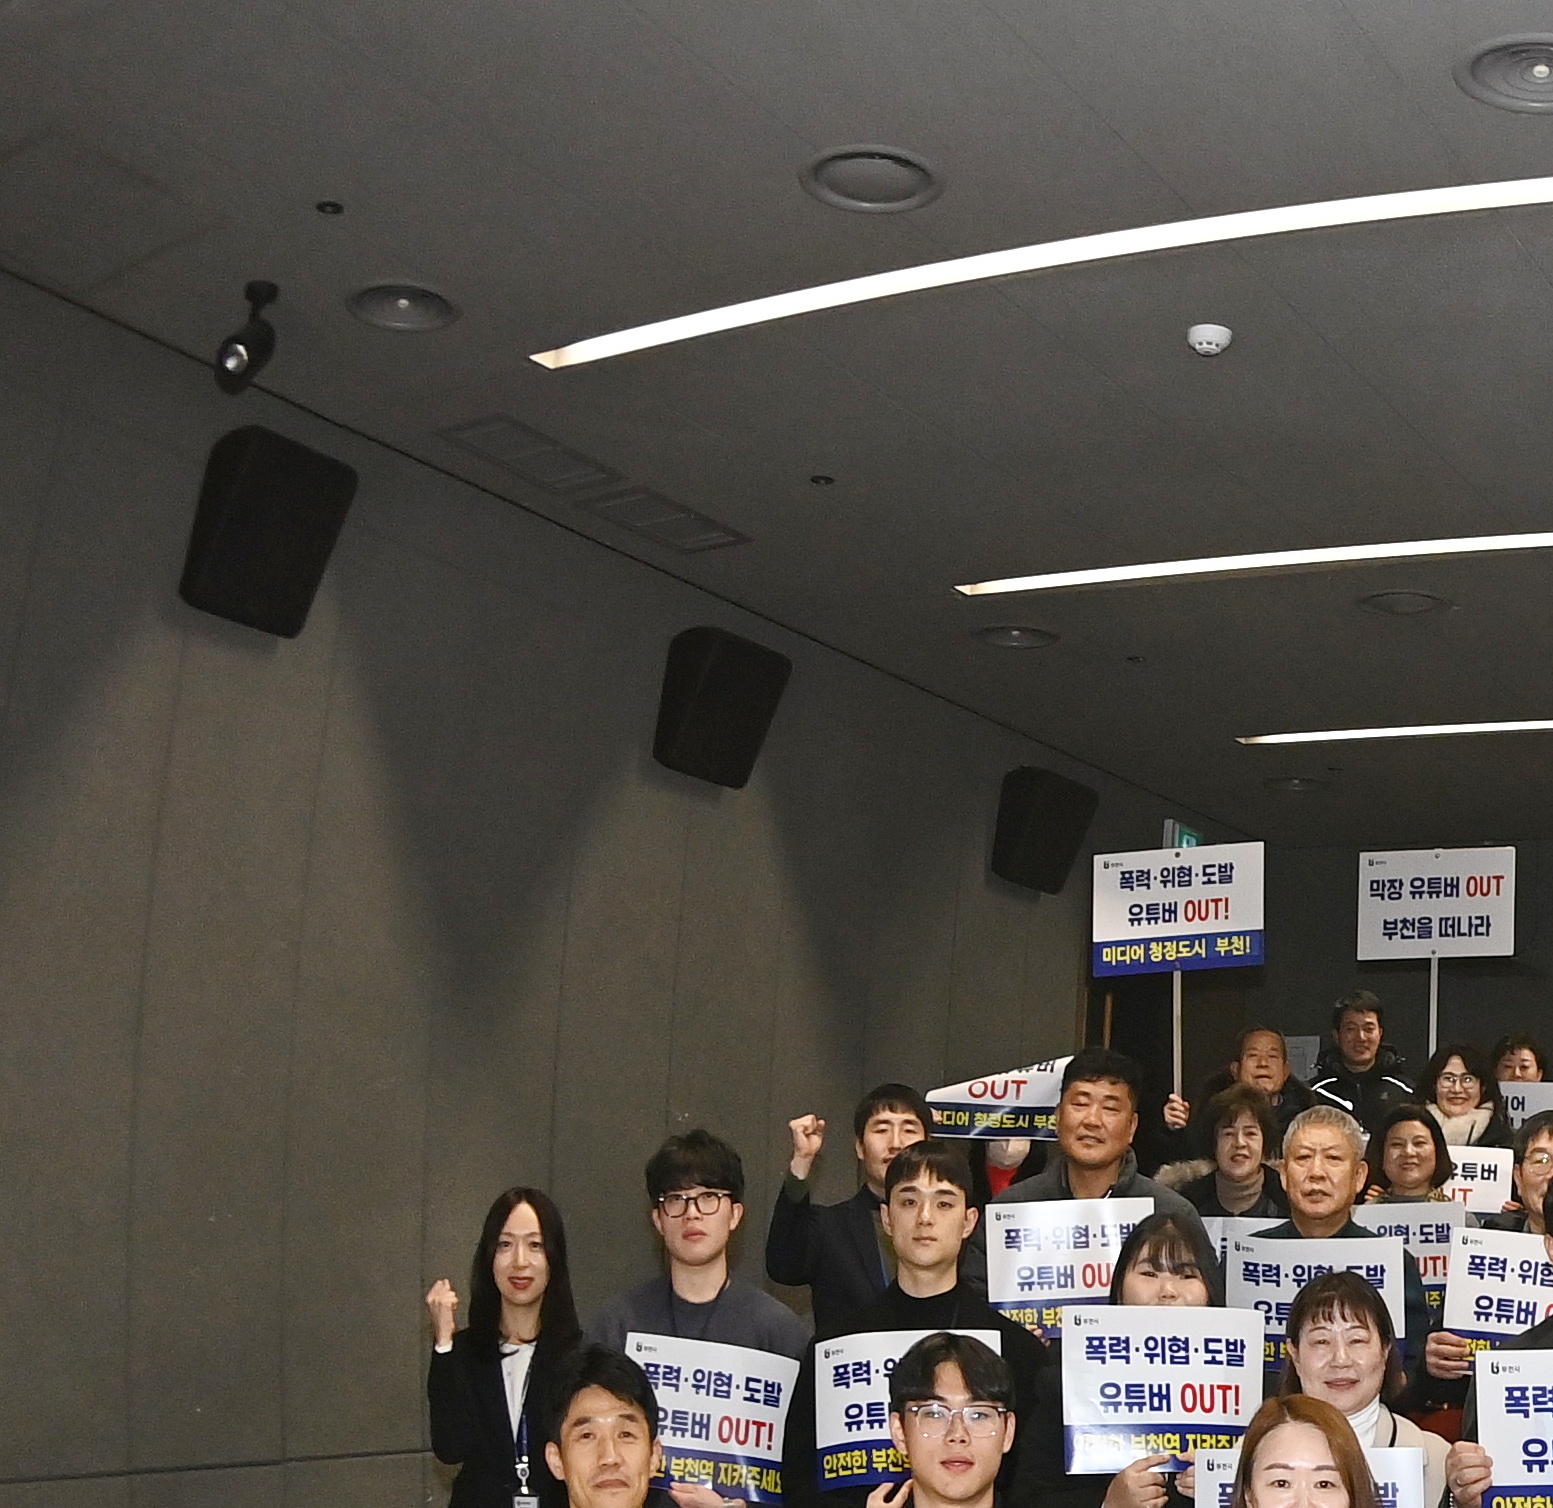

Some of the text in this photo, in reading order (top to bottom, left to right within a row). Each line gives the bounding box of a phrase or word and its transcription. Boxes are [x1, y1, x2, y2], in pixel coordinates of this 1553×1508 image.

[1120, 862, 1234, 891] 폭력·위협·도발
[1370, 875, 1504, 901] 막장 유튜버 OUT
[1128, 897, 1228, 926] 유튜버 OUT!
[1382, 915, 1491, 940] 부천을 떠나라
[1103, 936, 1250, 964] 미디어 청정도시 부천!
[1086, 1336, 1246, 1367] 폭력·위협·도발
[1100, 1383, 1239, 1415] 유튜버 OUT!
